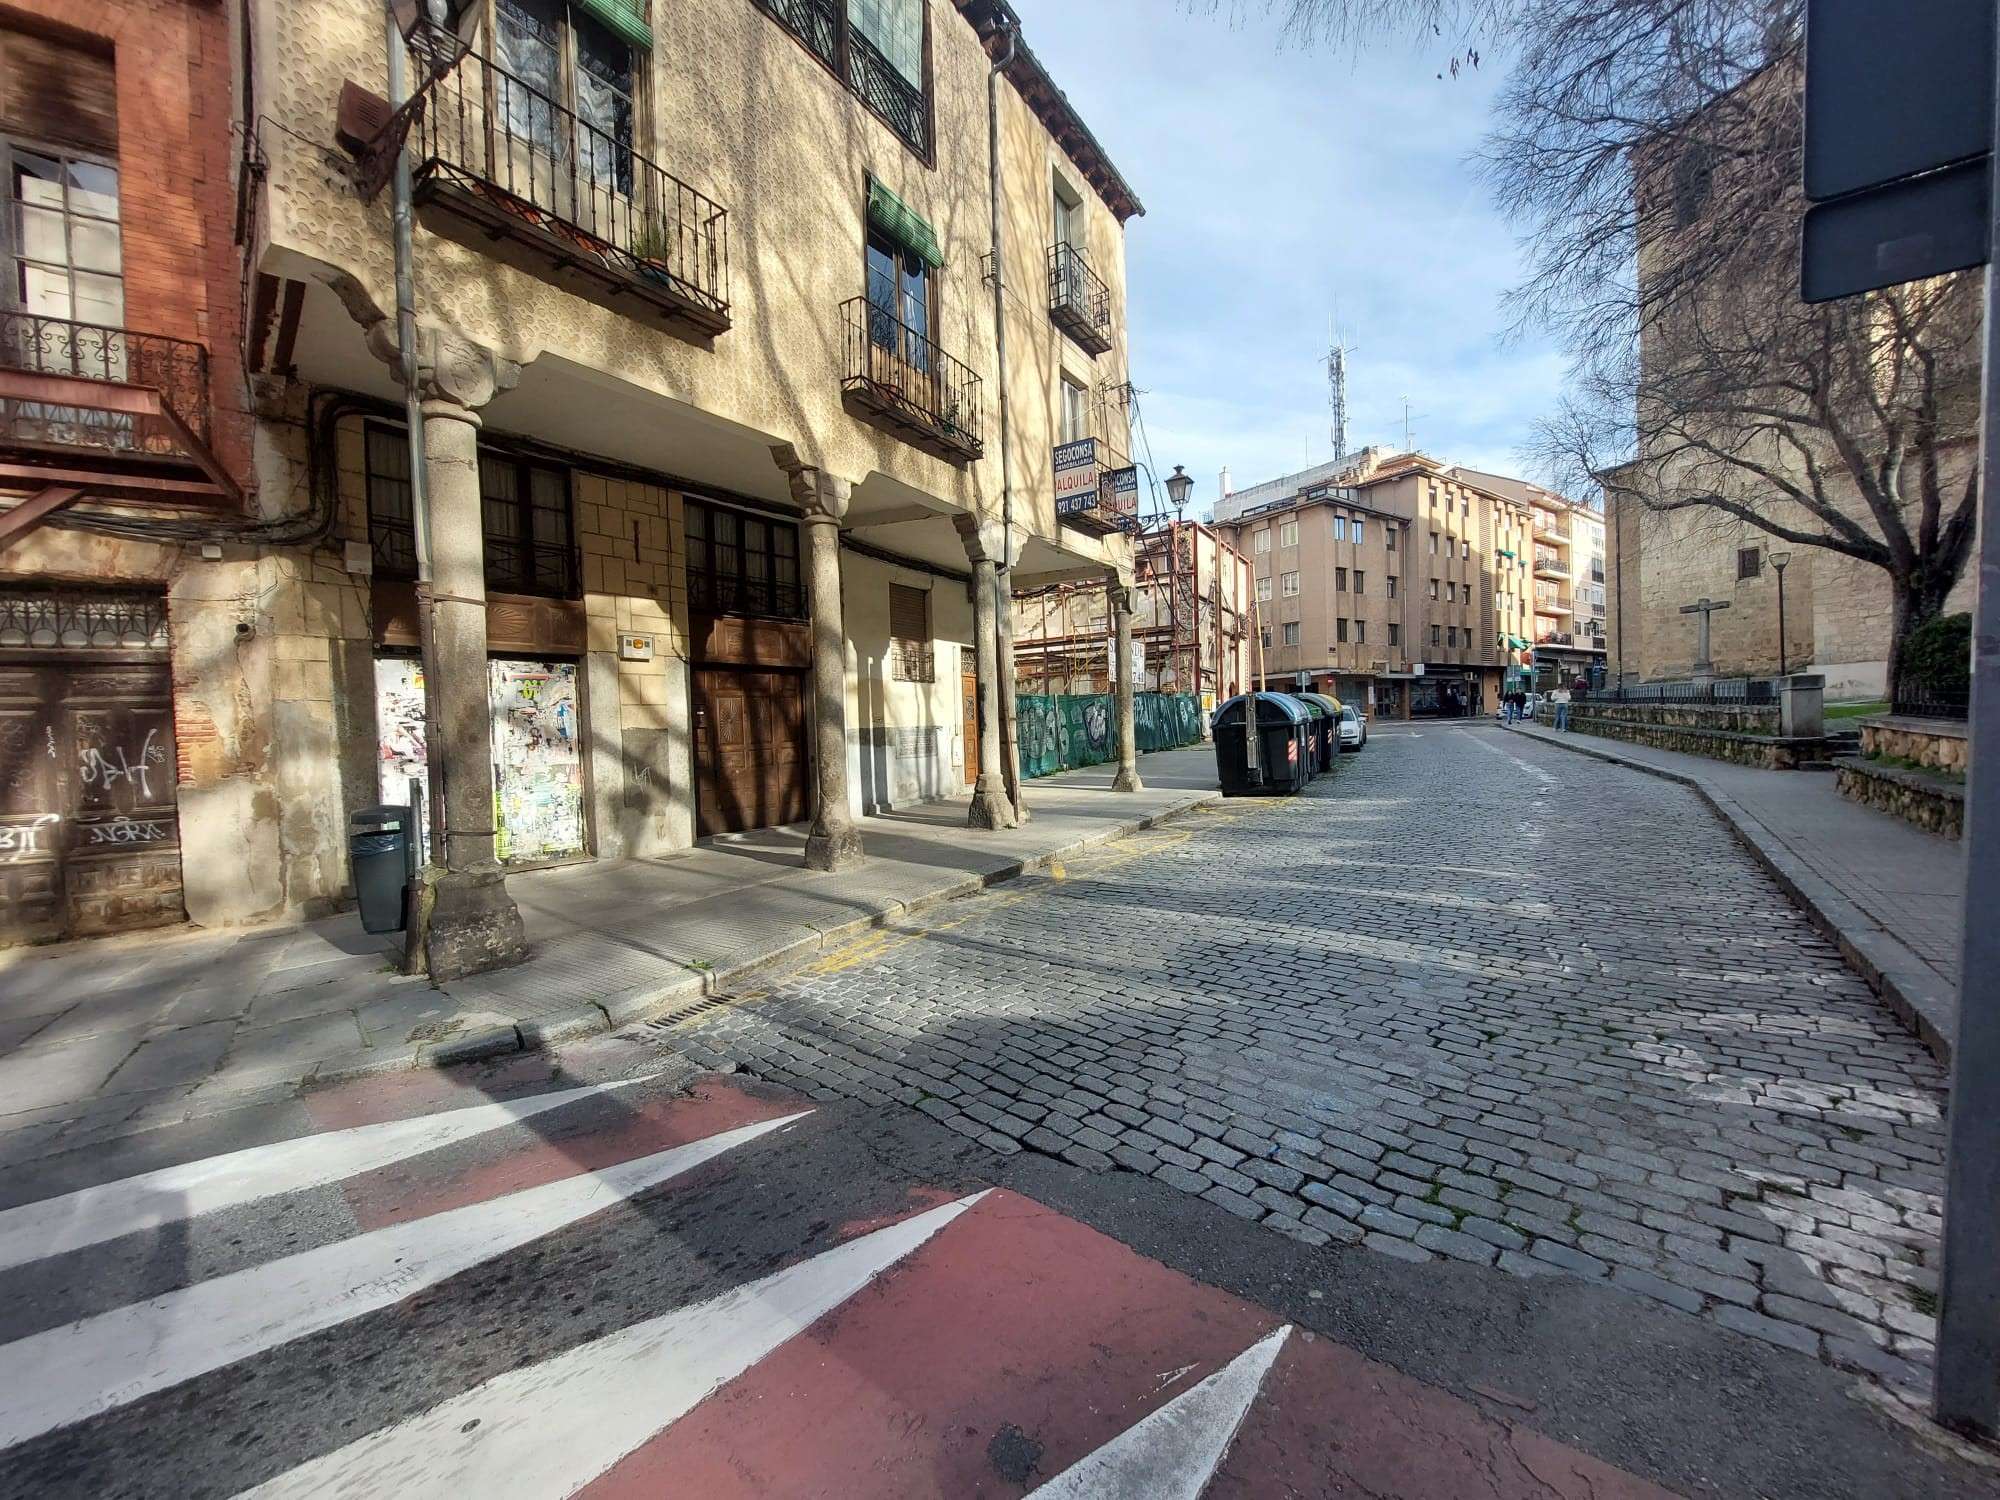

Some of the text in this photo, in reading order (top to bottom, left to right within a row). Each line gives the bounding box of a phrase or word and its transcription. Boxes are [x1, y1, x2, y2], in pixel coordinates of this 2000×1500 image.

[1055, 442, 1093, 465] SEGOCONSA
[1056, 471, 1094, 492] ALQUILA
[1057, 494, 1096, 514] 921 437 743
